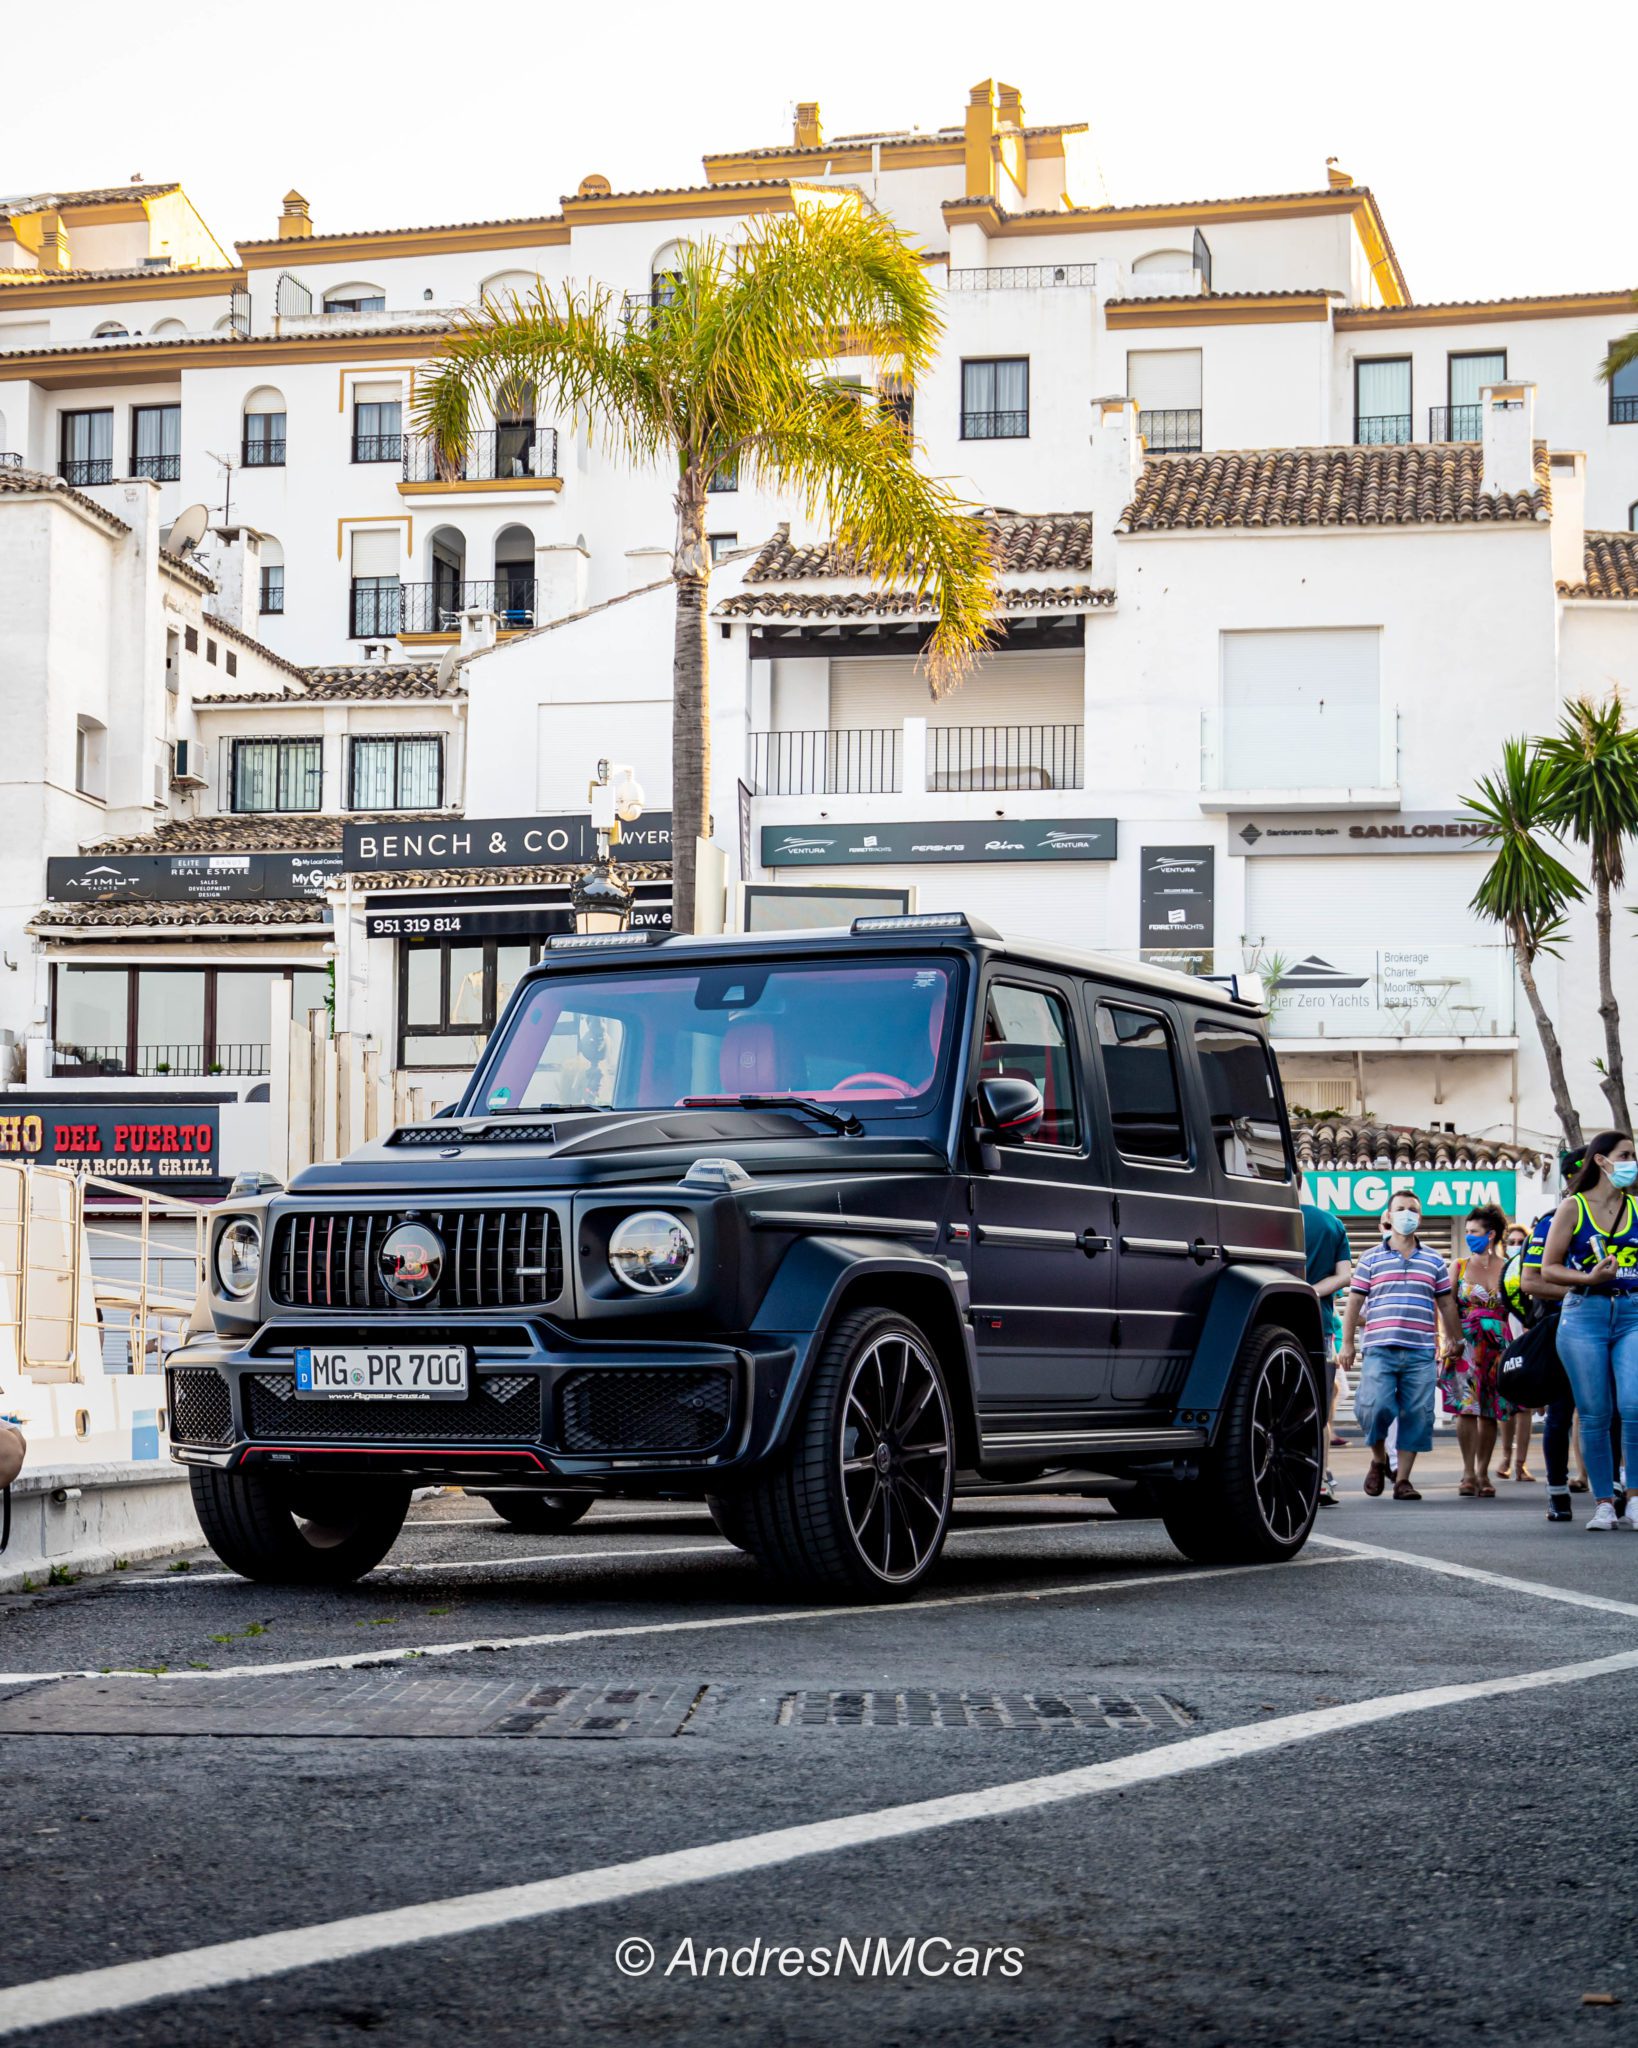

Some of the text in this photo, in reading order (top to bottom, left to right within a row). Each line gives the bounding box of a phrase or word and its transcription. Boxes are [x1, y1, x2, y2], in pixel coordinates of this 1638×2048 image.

[1266, 827, 1339, 837] Sanlorenzo Spain
[360, 829, 672, 858] BENCH & CO WYER
[985, 840, 1025, 850] Riva
[177, 859, 200, 867] ELITE
[171, 867, 249, 876] REAL ESTATE
[66, 878, 140, 886] AZIMUT
[373, 917, 461, 934] 951 319 814
[1384, 952, 1429, 963] Brokerage
[1384, 967, 1417, 978] Charter
[1384, 983, 1425, 994] Moorings
[1297, 993, 1325, 1008] Zero
[1330, 993, 1370, 1007] Yachts
[54, 1125, 102, 1152] DEL
[114, 1124, 212, 1152] PUERTO
[158, 1158, 213, 1176] GRILL
[1427, 1181, 1500, 1206] ATM
[313, 1354, 462, 1385] MG PR 700
[301, 1373, 308, 1384] D
